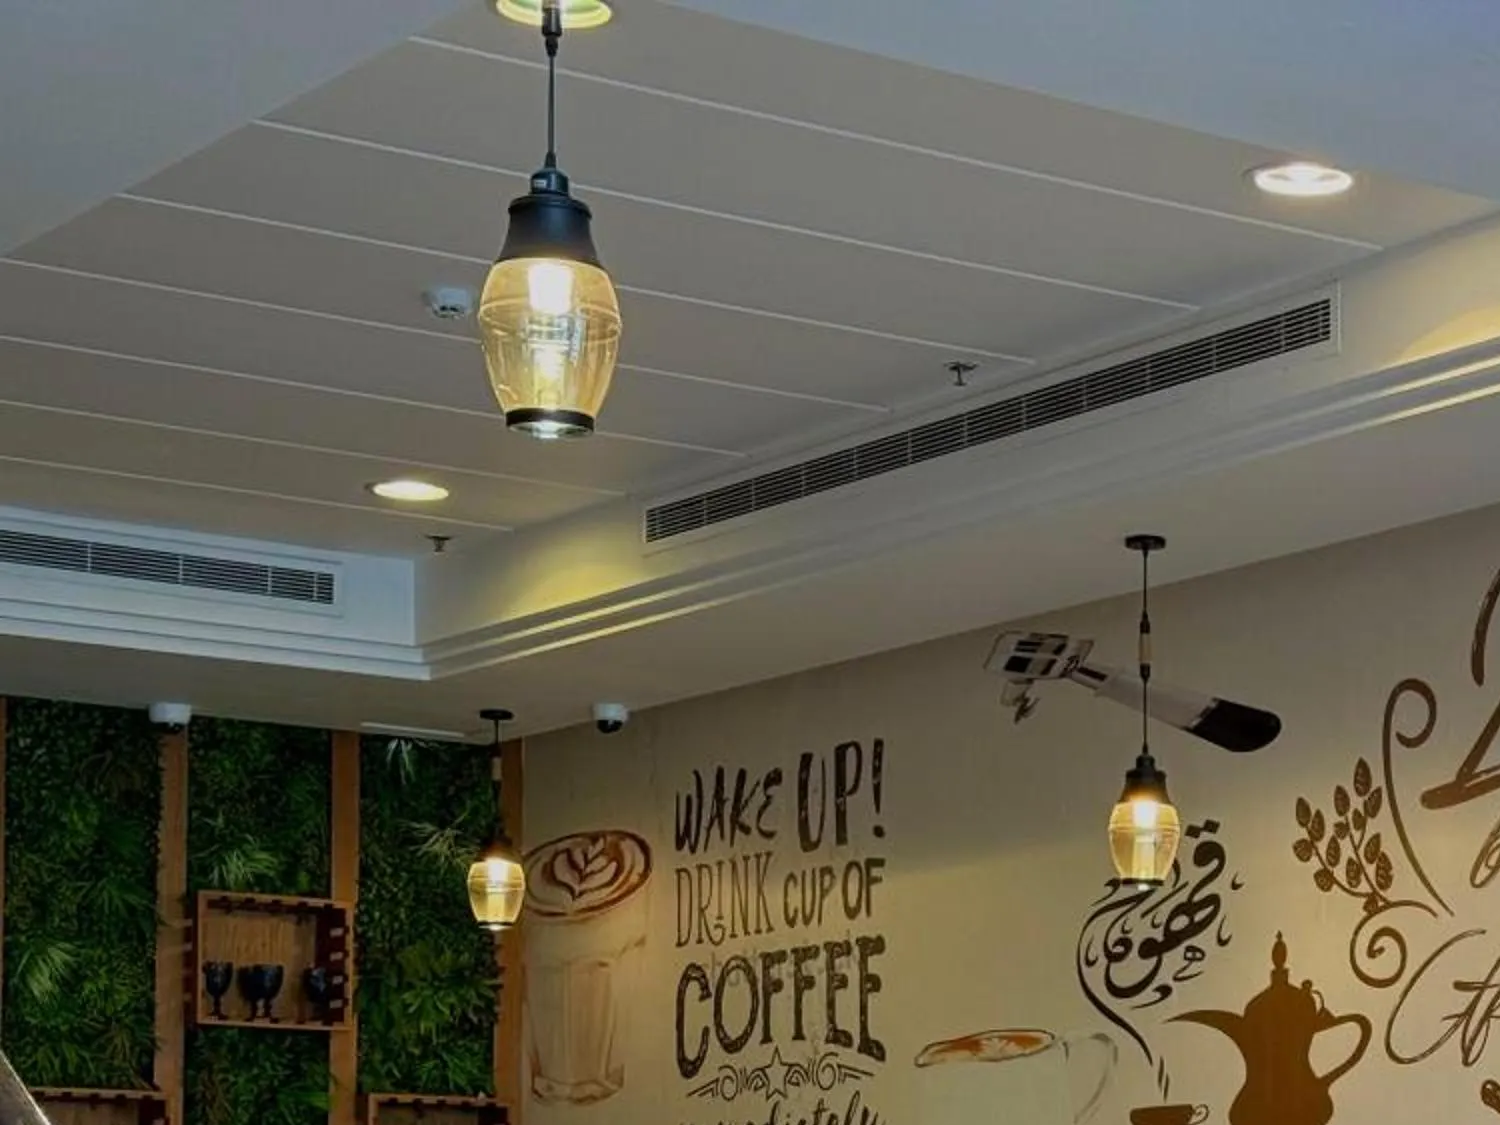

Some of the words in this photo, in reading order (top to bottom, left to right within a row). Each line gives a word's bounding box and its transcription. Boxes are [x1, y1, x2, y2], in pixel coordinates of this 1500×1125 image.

[675, 765, 783, 854] WAKE
[797, 737, 885, 853] UP!
[675, 851, 775, 948] DRINK
[783, 865, 836, 929] CUP
[842, 857, 886, 921] OF
[676, 934, 887, 1079] COFFEE
